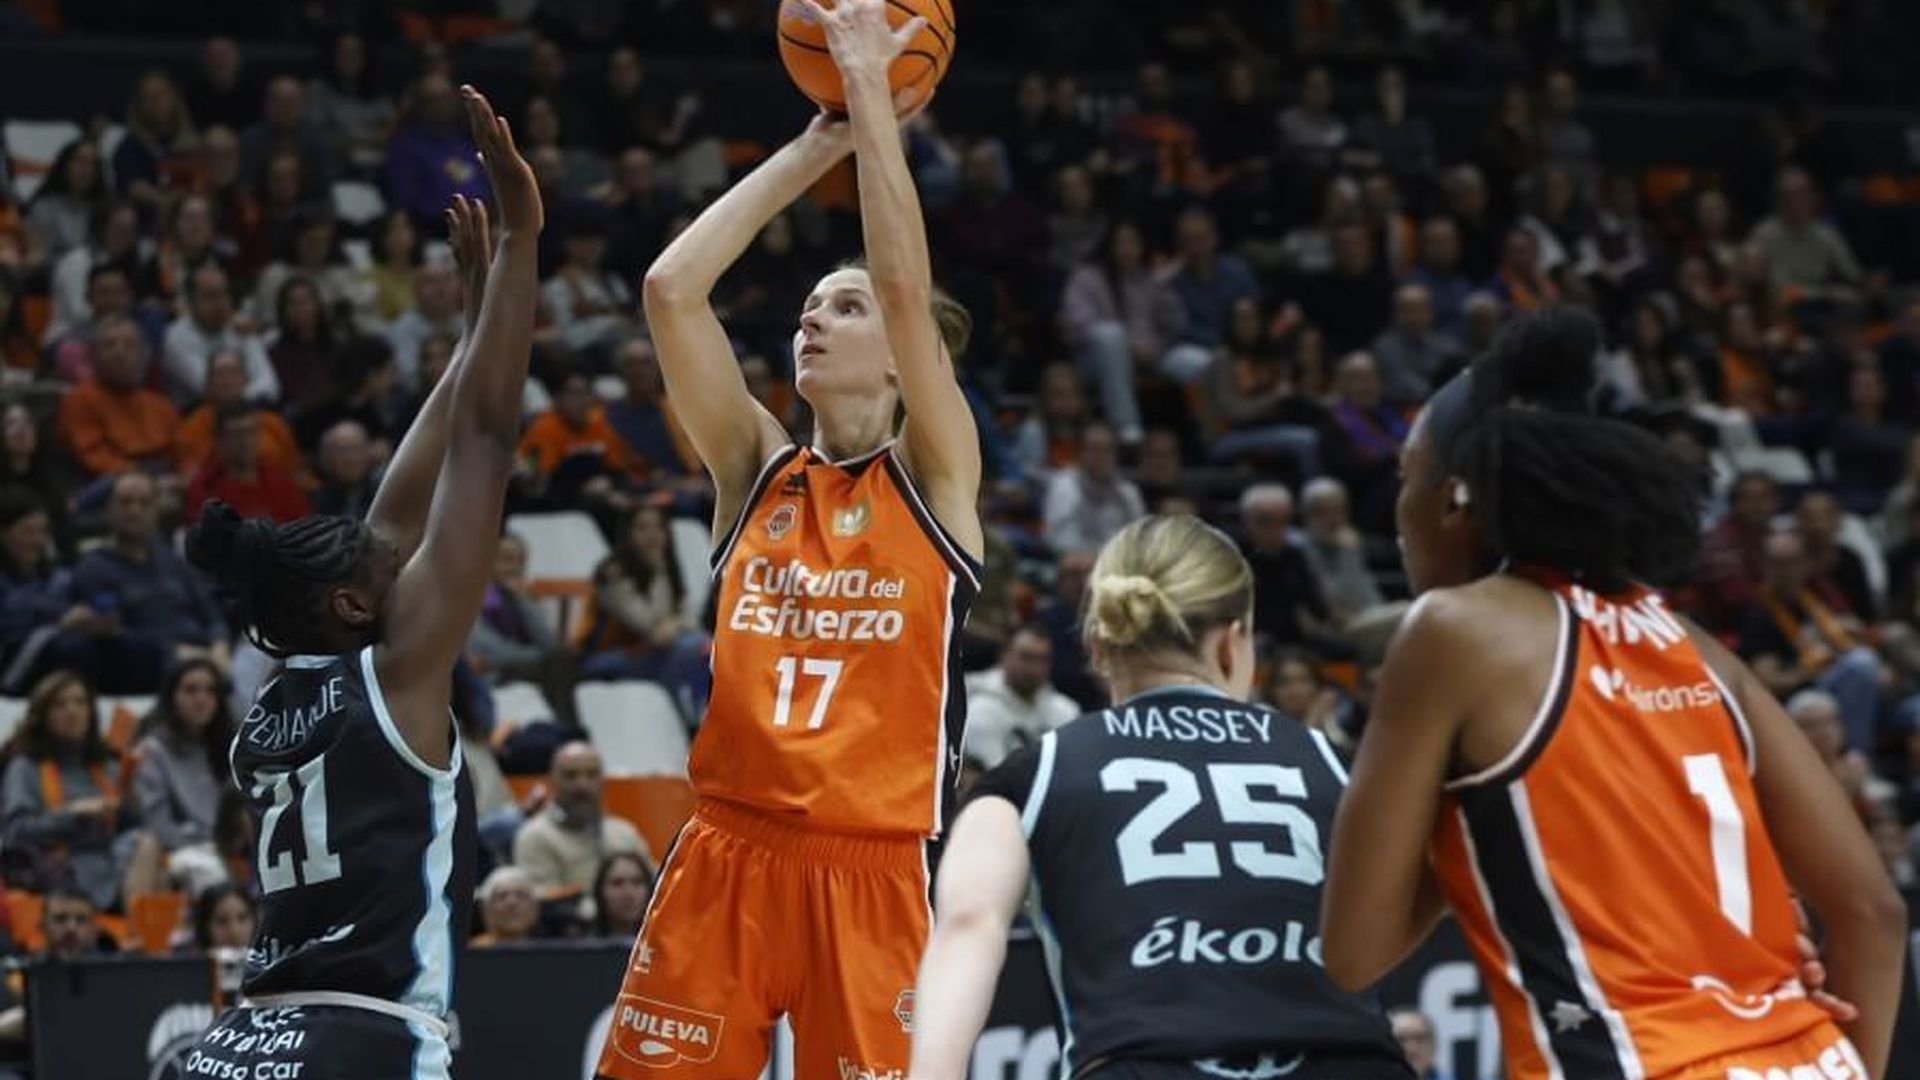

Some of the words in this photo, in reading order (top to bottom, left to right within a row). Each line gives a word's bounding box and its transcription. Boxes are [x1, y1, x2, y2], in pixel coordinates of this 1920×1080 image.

[743, 556, 869, 598] Cultura
[870, 579, 905, 600] del
[730, 595, 904, 642] Esfuerzo
[773, 656, 844, 730] 17
[1103, 705, 1273, 743] MASSEY
[250, 753, 342, 894] 21
[1100, 757, 1325, 886] 25
[1681, 752, 1752, 938] 1
[620, 1005, 709, 1047] PULEVA
[254, 1061, 305, 1080] Car
